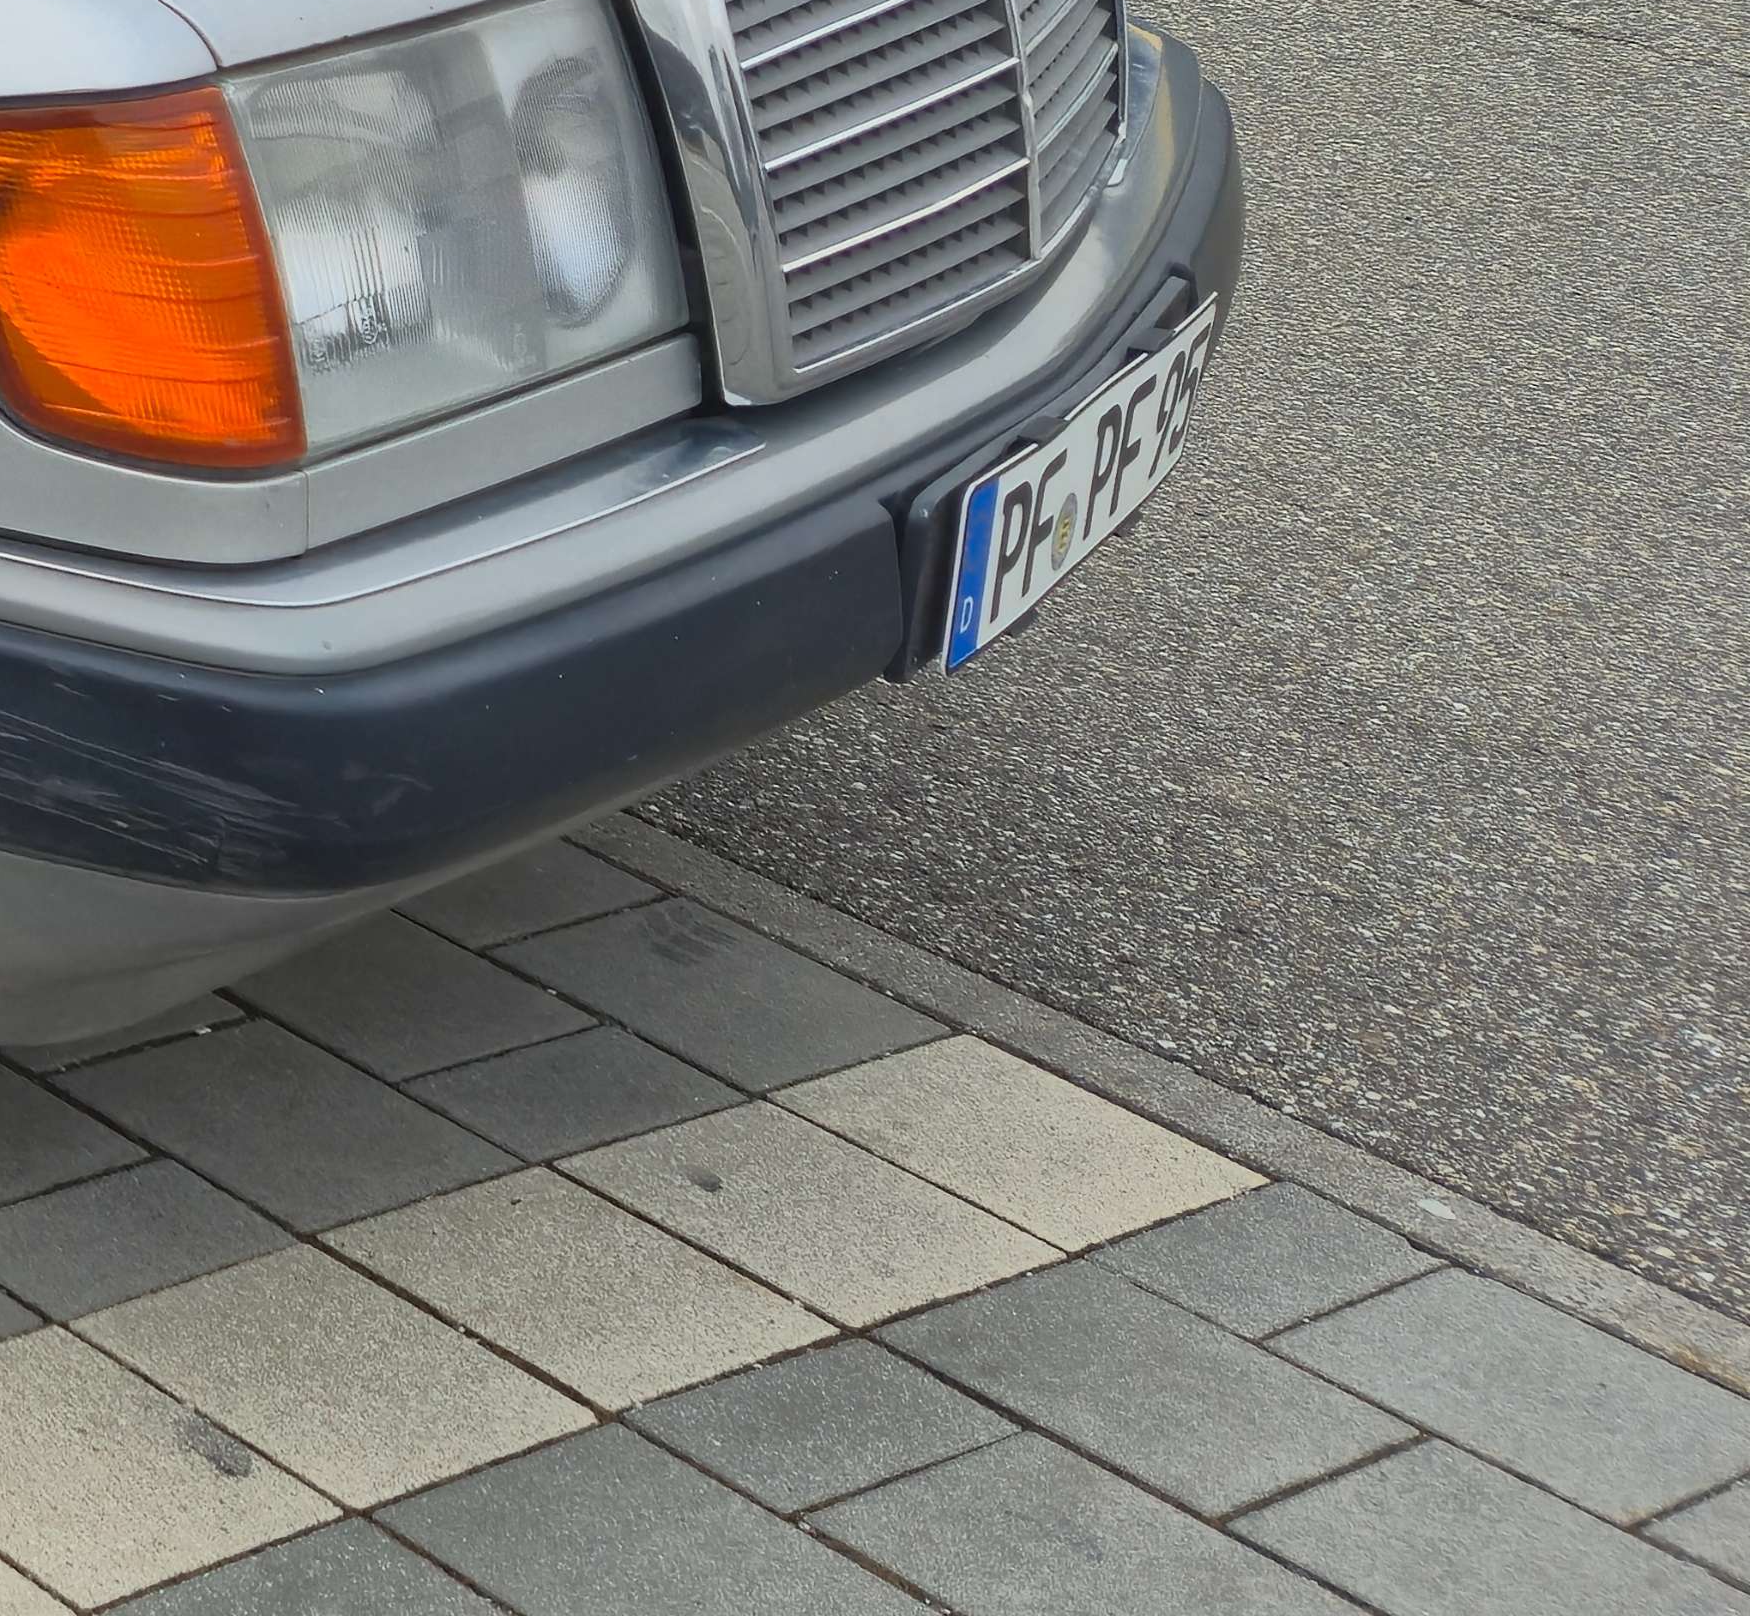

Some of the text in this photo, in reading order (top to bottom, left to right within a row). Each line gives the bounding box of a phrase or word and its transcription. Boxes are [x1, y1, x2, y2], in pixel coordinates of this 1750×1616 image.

[989, 322, 1211, 624] PF PF 95
[959, 596, 975, 634] D
